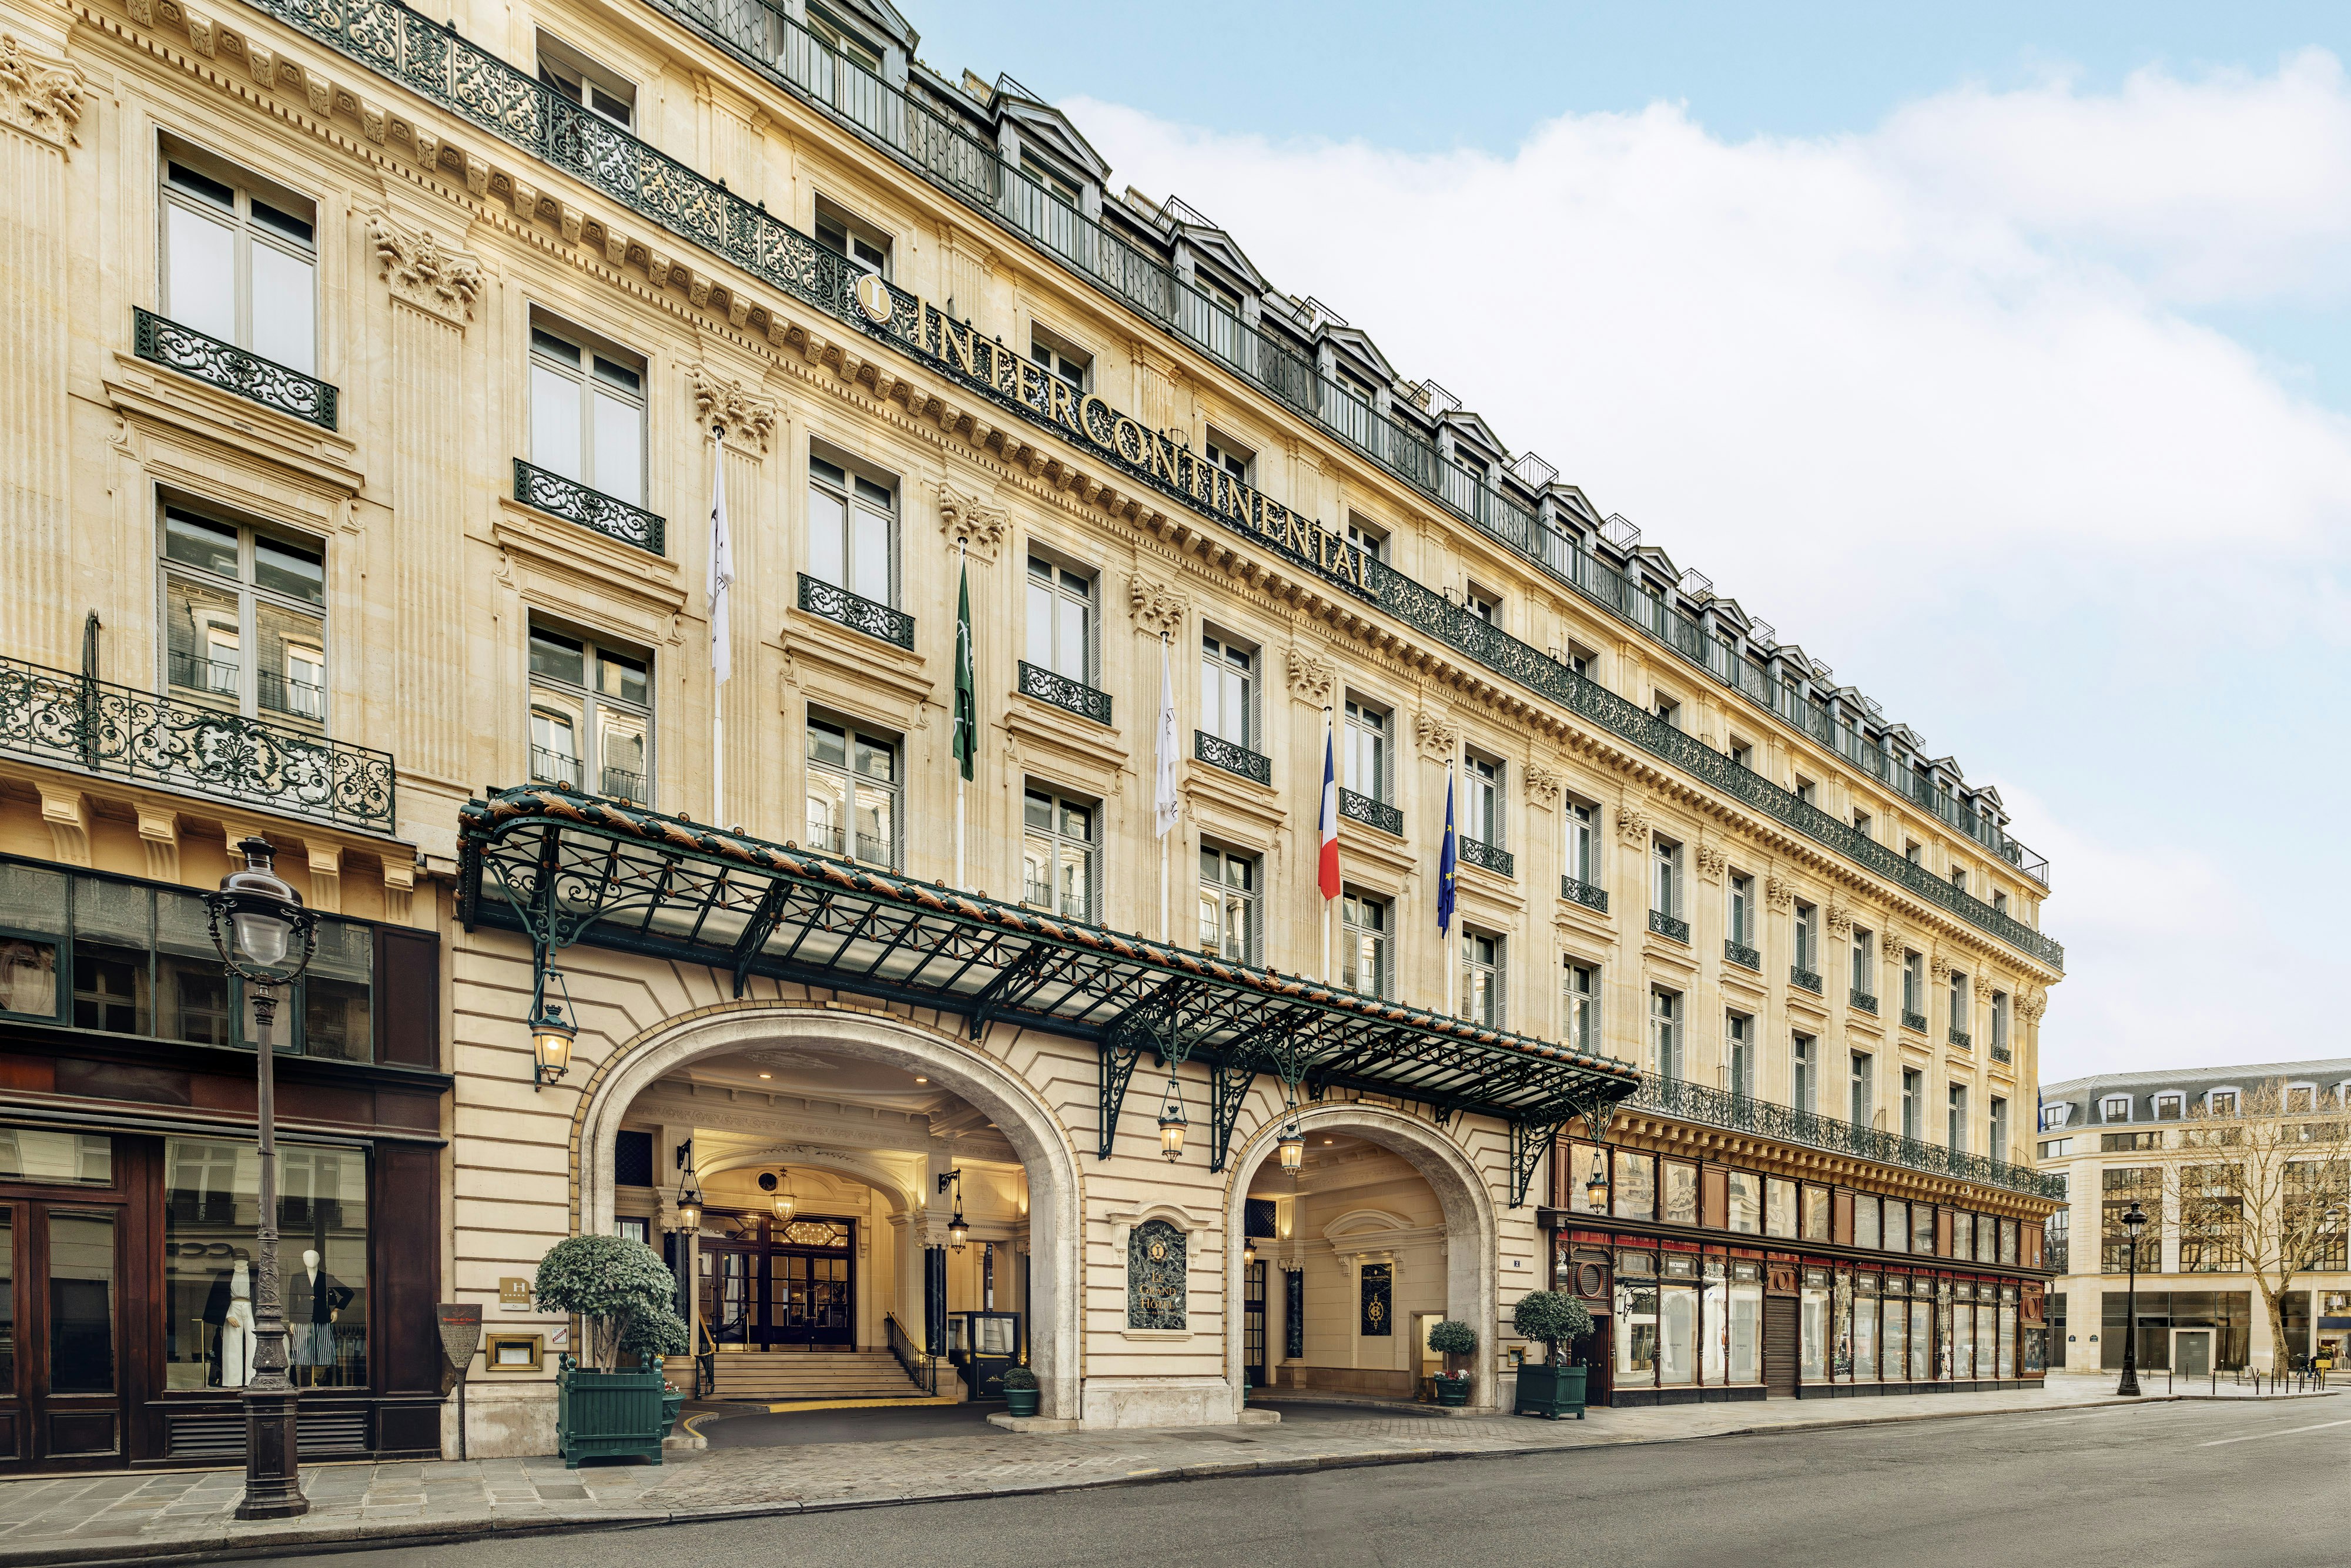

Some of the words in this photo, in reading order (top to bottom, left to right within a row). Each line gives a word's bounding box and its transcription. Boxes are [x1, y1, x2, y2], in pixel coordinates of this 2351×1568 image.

[915, 294, 1375, 595] INTERCONTINENTAL
[1151, 1272, 1164, 1282] LE
[513, 1282, 525, 1292] H
[1140, 1284, 1176, 1296] GRAND
